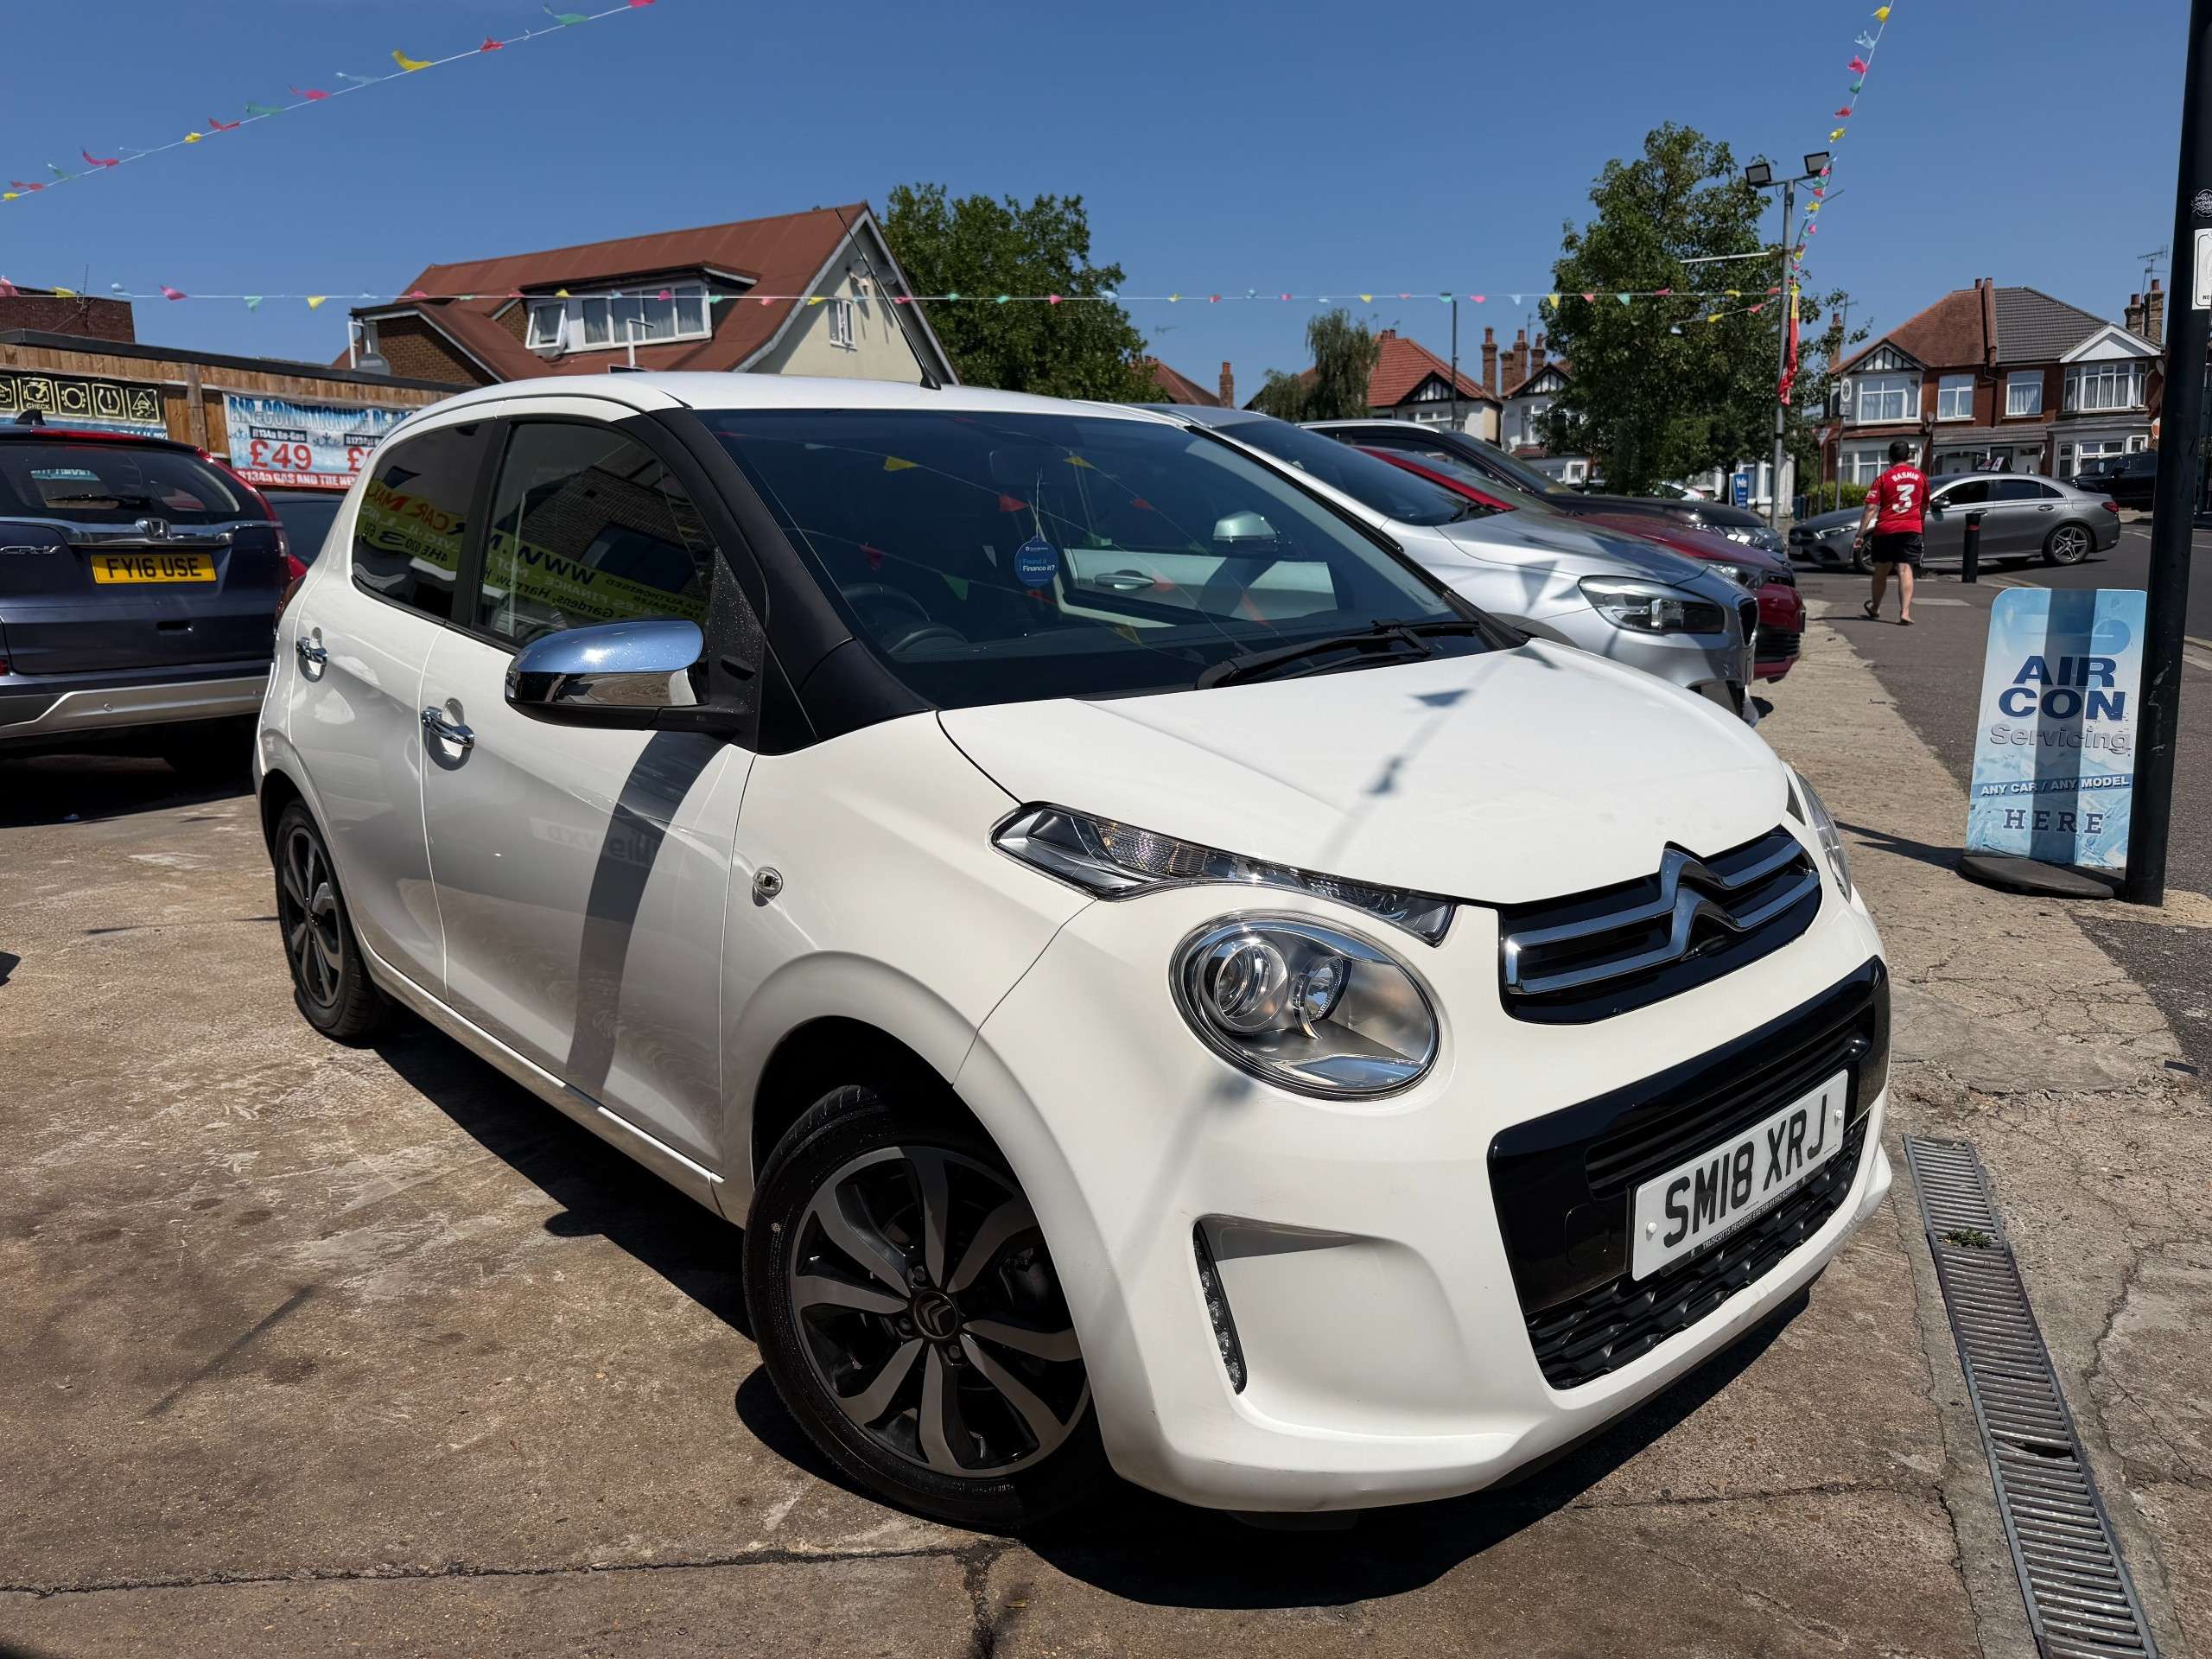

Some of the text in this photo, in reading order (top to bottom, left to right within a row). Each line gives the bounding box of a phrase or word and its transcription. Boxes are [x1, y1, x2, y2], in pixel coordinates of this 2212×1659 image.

[26, 402, 50, 410] CHECK
[250, 439, 312, 471] £49
[274, 473, 295, 485] GAS
[296, 474, 318, 486] AND
[319, 475, 339, 486] THE
[1892, 484, 1915, 514] 3
[105, 557, 203, 579] FY16 USE
[2013, 655, 2117, 688] AIR
[1999, 687, 2126, 721] CON
[1989, 723, 2132, 755] Servicing
[1981, 784, 2007, 796] ANY
[2011, 782, 2037, 794] CAR
[2051, 779, 2078, 791] ANY
[2081, 776, 2130, 789] MODEL
[2003, 809, 2104, 835] HERE
[1663, 1093, 1827, 1249] SM18 XRJ
[1731, 1215, 1752, 1232] PEUGEOT
[1752, 1204, 1770, 1218] EXETER
